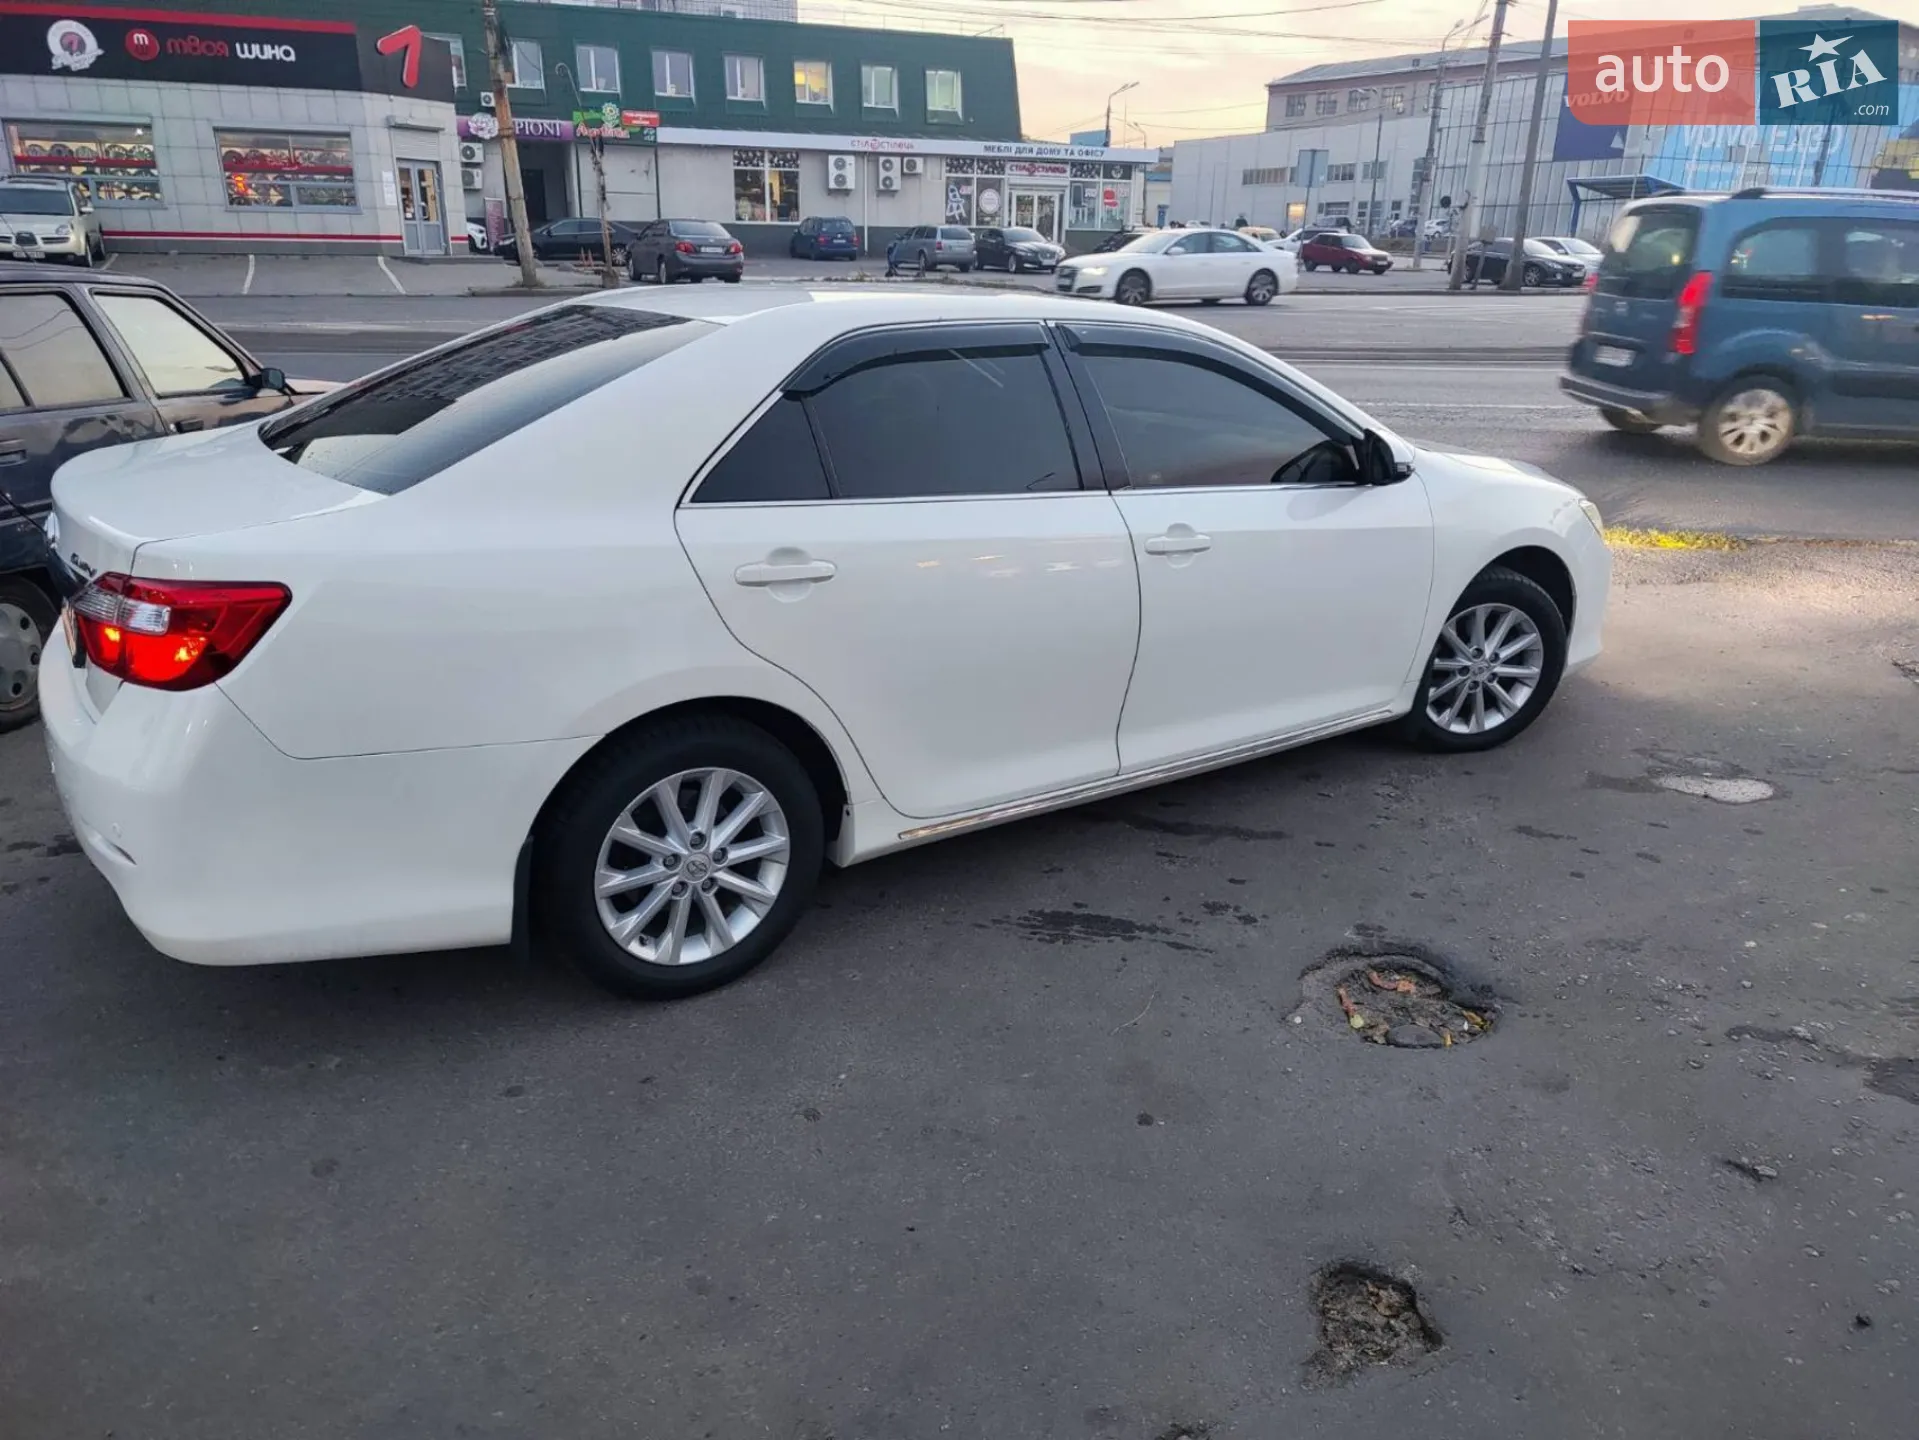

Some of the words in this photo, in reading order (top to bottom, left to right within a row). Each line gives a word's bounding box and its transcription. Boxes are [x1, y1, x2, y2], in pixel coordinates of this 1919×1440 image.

[235, 41, 297, 62] шина
[1563, 88, 1630, 108] VOLVO
[983, 145, 1012, 153] МЕБЛІ
[1014, 145, 1034, 155] ДЛЯ
[1036, 146, 1061, 156] ДОМУ
[1064, 146, 1075, 156] ТА
[1077, 147, 1105, 158] ОФІСУ
